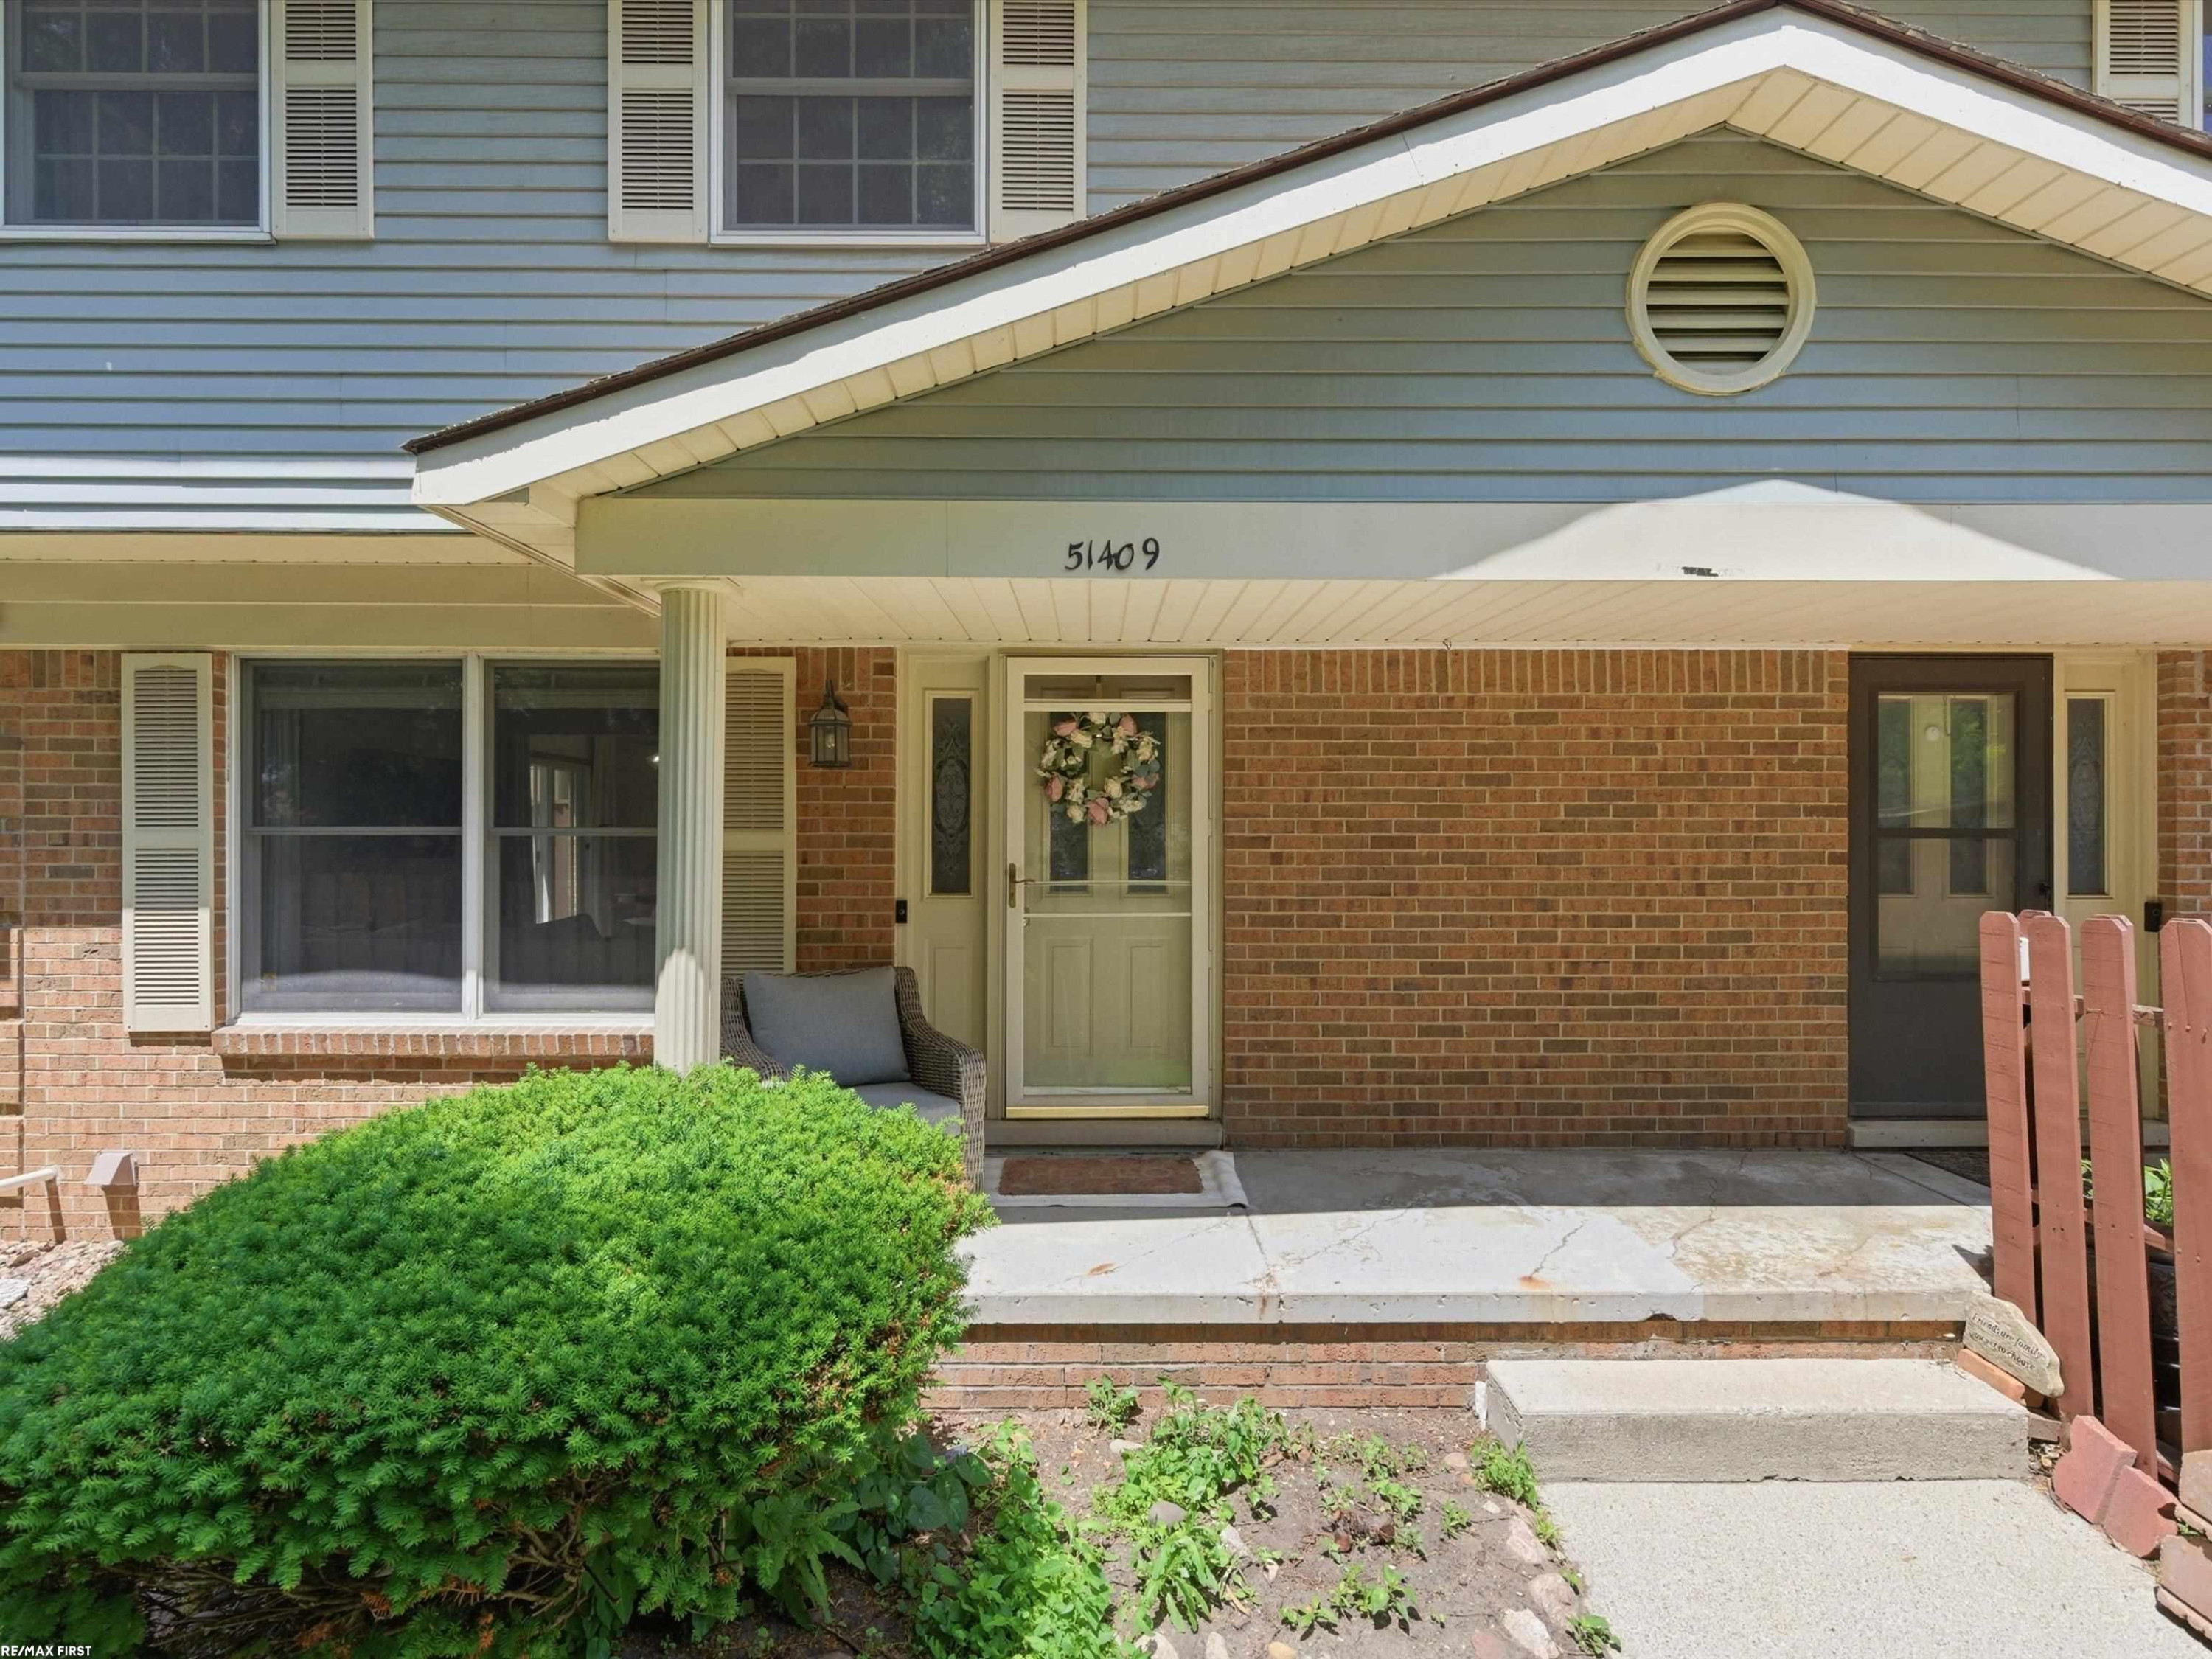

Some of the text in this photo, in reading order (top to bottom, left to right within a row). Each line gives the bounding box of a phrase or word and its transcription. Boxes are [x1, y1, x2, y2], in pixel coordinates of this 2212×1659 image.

[1065, 538, 1160, 571] 51409
[2000, 1330, 2014, 1340] are
[1997, 1344, 2006, 1354] to
